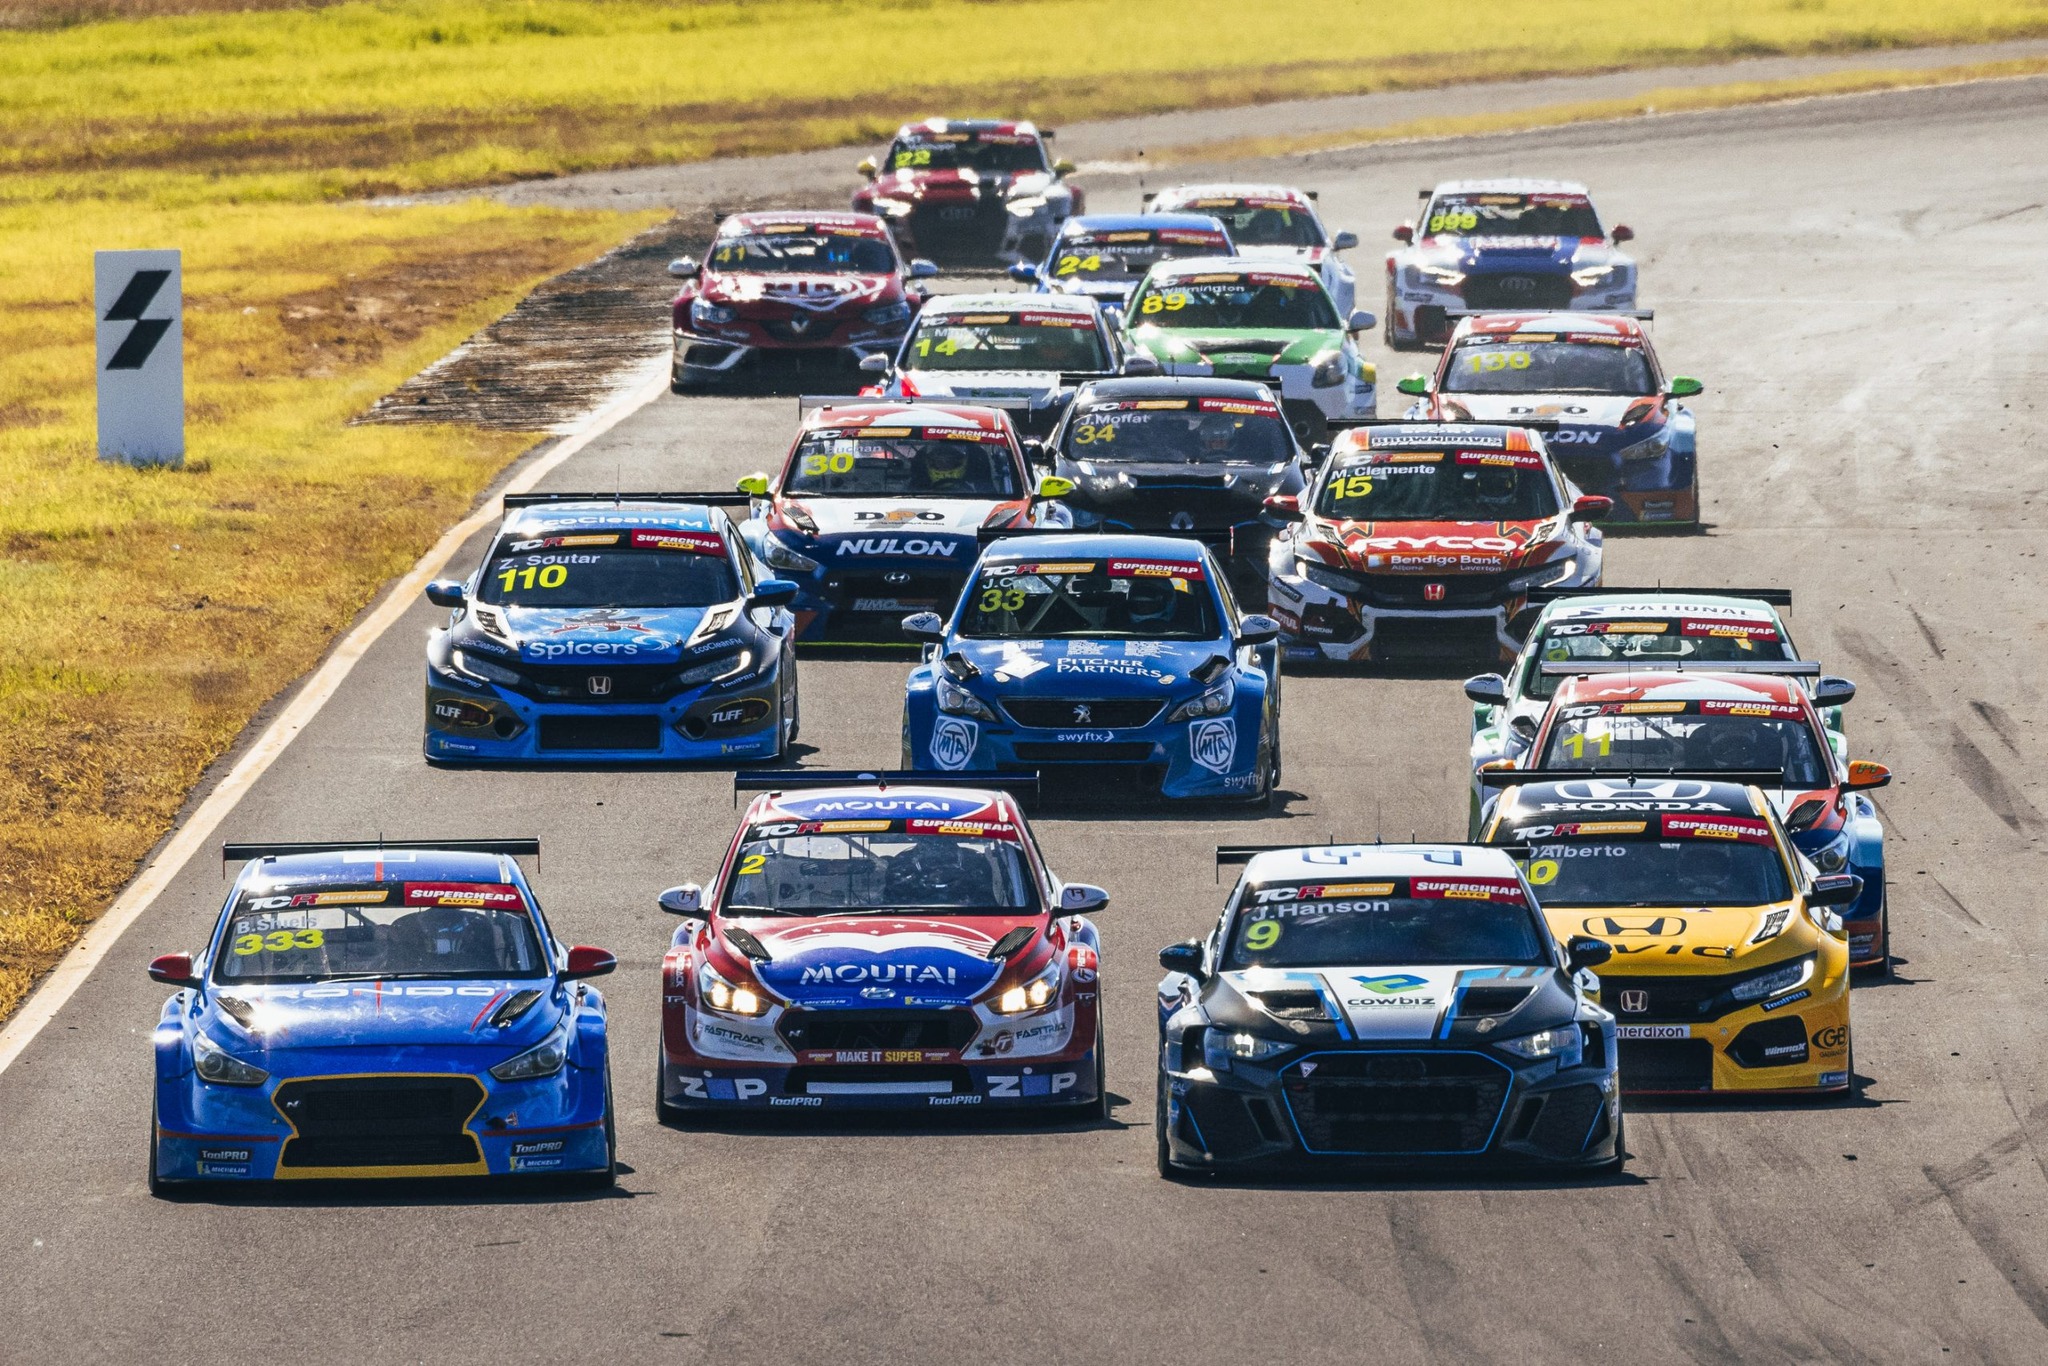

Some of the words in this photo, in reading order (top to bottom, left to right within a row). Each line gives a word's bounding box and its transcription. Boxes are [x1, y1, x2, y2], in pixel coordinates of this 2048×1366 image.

[1430, 214, 1477, 232] 999
[1056, 256, 1101, 276] 24
[1141, 292, 1187, 314] 89
[915, 338, 958, 356] 14
[1466, 352, 1531, 373] 130
[809, 429, 860, 440] TCR
[926, 428, 1004, 439] SUPERCHEAP
[1075, 424, 1116, 444] 34
[1545, 431, 1602, 444] LON
[804, 453, 855, 476] 30
[1341, 454, 1394, 467] TCR
[1460, 452, 1539, 464] SUPERCHEAP
[1331, 470, 1351, 480] M.
[1355, 465, 1436, 476] Clemente
[1328, 476, 1372, 500] 15
[535, 515, 704, 529] coCleanFM
[854, 511, 946, 521] DPO
[510, 537, 565, 551] TCR
[637, 534, 720, 548] SUPERCHEAP
[836, 538, 958, 557] NULON
[1349, 536, 1518, 554] RYCO
[500, 557, 519, 569] Z.
[527, 553, 601, 567] Soutar
[1391, 555, 1458, 567] Bendigo
[1461, 555, 1502, 565] Bank
[982, 566, 1041, 578] TCR
[1041, 566, 1092, 575] Australia
[1113, 562, 1199, 577] SUPERCHEAP
[498, 565, 567, 593] 110
[979, 590, 1026, 613] 33
[1620, 605, 1749, 615] NATIONAL
[1551, 623, 1618, 637] TCR
[1687, 623, 1775, 636] SUPERCHEAP
[460, 637, 508, 655] EcoCleanFM
[529, 640, 638, 660] Spicers
[694, 638, 743, 655] EcoCleanFM
[1056, 657, 1145, 668] PITCHER
[1056, 665, 1163, 679] PARTNERS
[435, 704, 462, 718] TUFF
[1562, 704, 1626, 718] TCR
[1623, 703, 1681, 712] Australia
[1706, 701, 1799, 714] SUPERCHEAP
[712, 709, 743, 723] TUFF
[1056, 731, 1103, 745] swyftx
[1562, 732, 1611, 759] 11
[814, 800, 951, 812] MOUTAI
[1541, 802, 1732, 812] HONDA
[756, 822, 825, 838] TCR
[822, 822, 889, 832] Australia
[912, 819, 1015, 832] SUPERCHEAP
[1512, 823, 1581, 842] TCR
[1580, 823, 1643, 833] Australia
[1667, 820, 1769, 837] SUPERCHEAP
[1699, 830, 1734, 838] AUTO
[738, 855, 767, 875] 2
[1517, 859, 1559, 886] 0
[1254, 884, 1325, 903] TCR
[1322, 885, 1390, 895] Australia
[1416, 881, 1522, 896] SUPERCHEAP
[1448, 891, 1490, 899] AUTO
[247, 893, 322, 911] TCR
[319, 892, 384, 903] Australia
[410, 889, 517, 903] SUPERCHEAP
[1251, 899, 1390, 921] J.Hanson
[1246, 920, 1280, 950] 9
[233, 930, 325, 956] 333
[1613, 944, 1737, 959] VIC
[799, 964, 957, 987] MOUTAI
[1346, 996, 1436, 1006] cowbiz
[1763, 990, 1807, 1009] ToolPRO
[704, 1024, 765, 1046] FASTTRACK
[1615, 1026, 1685, 1038] nterdixon
[835, 1051, 868, 1062] MAKE
[870, 1051, 882, 1062] IT
[884, 1051, 923, 1062] SUPER
[769, 1096, 823, 1107] ToolPRO
[928, 1095, 982, 1106] ToolPRO
[201, 1149, 249, 1161] ToolPRO
[514, 1141, 563, 1155] ToolPRO
[210, 1165, 248, 1175] MICHELIN
[523, 1158, 561, 1168] MICHELIN
